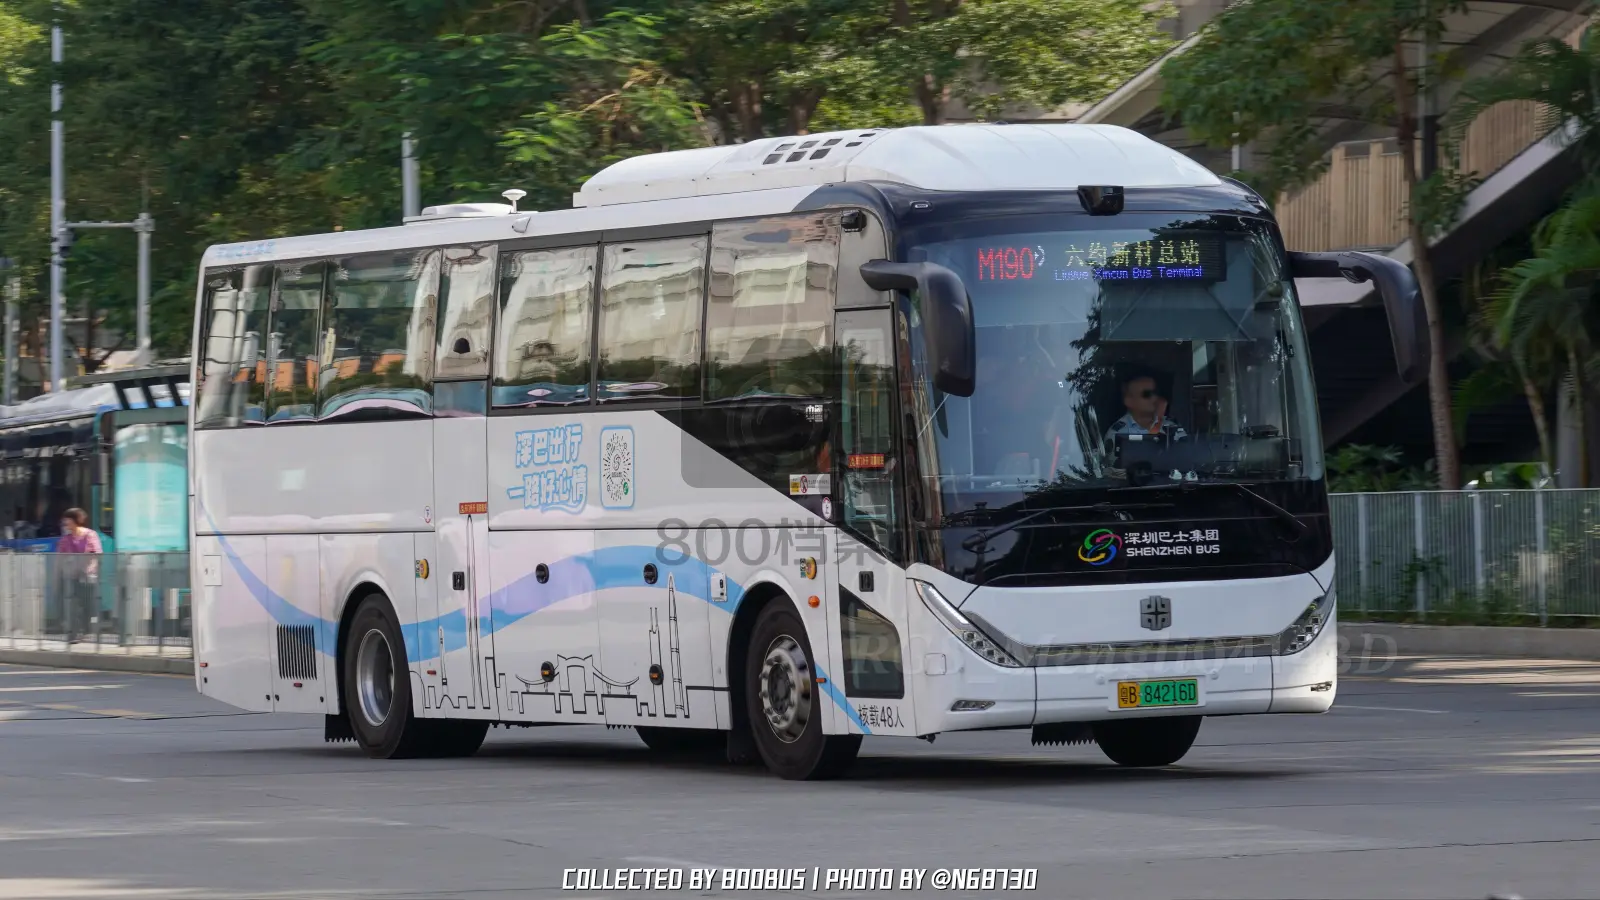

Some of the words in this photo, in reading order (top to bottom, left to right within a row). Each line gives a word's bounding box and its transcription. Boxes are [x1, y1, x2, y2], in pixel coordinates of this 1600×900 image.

[978, 247, 1034, 281] M190
[1065, 240, 1200, 266] 六约新村总站
[1132, 267, 1152, 279] Bus
[1157, 265, 1202, 278] Terminal
[515, 423, 583, 468] 深巴出行
[507, 464, 588, 512] 一路好心情
[1124, 529, 1220, 545] 深圳巴士集团
[1126, 546, 1193, 557] SHENZHEN
[1195, 544, 1221, 554] BUS
[858, 703, 905, 728] 核载48人
